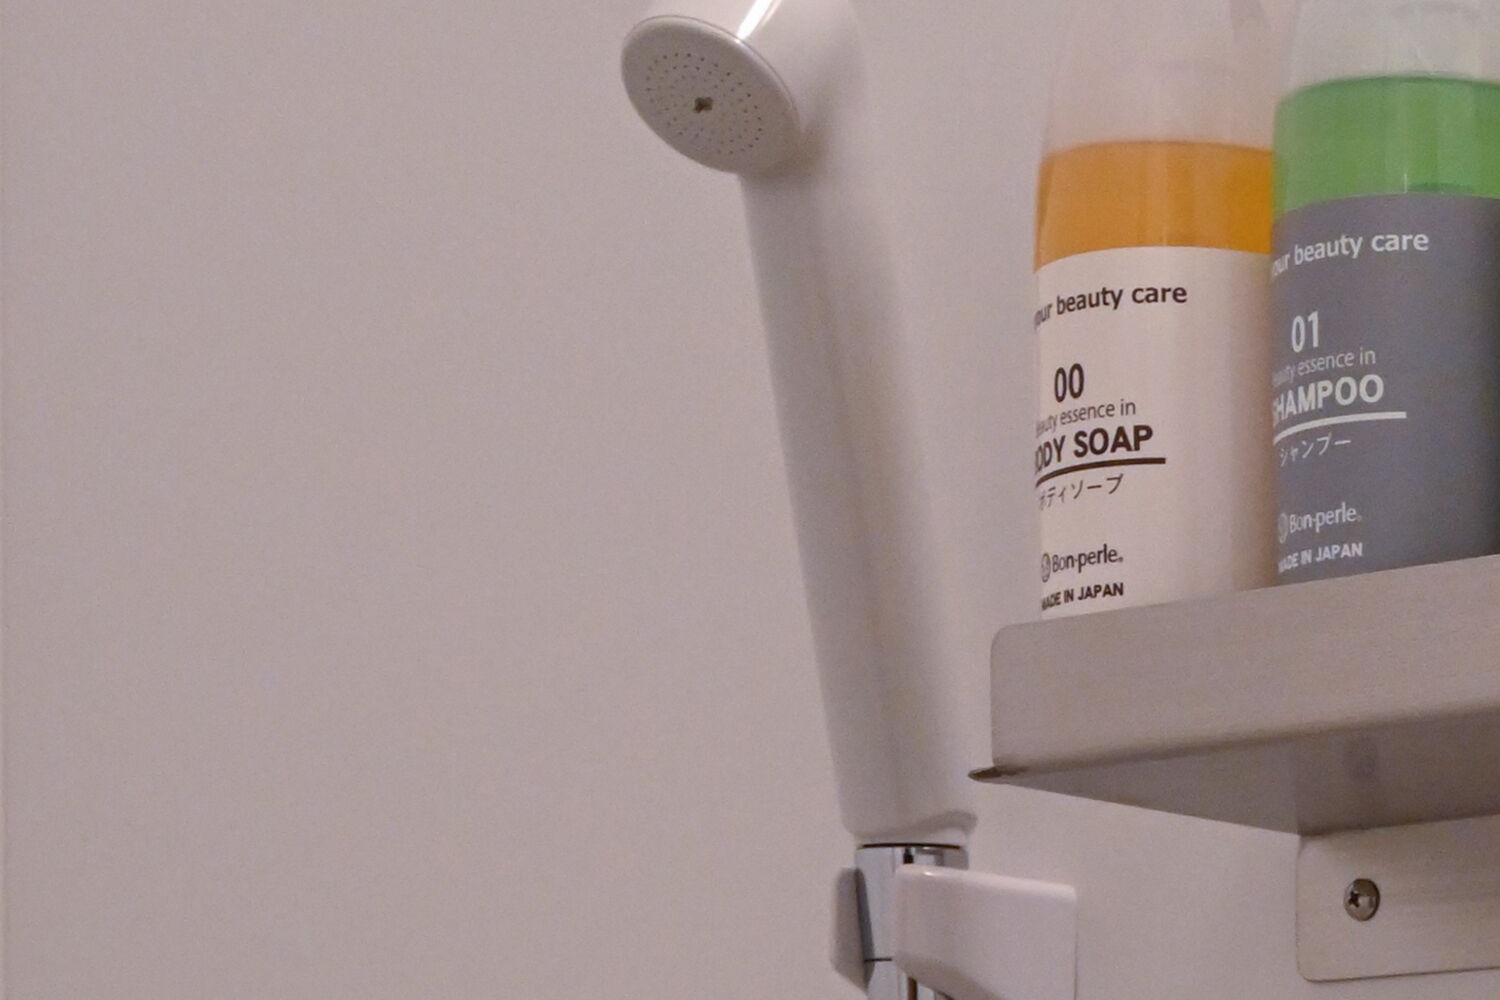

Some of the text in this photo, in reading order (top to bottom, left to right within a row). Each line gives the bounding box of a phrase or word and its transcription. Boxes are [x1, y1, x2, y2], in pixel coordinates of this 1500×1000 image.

[1272, 233, 1430, 276] our beauty care
[1034, 286, 1188, 330] our beauty care
[1291, 310, 1319, 353] 01
[1297, 351, 1355, 376] essence
[1359, 346, 1376, 365] in
[1054, 363, 1085, 403] 00
[1273, 373, 1385, 427] HAMPOO
[1060, 402, 1115, 425] essence
[1120, 399, 1136, 416] in
[1035, 424, 1153, 475] ODY SOAP
[1279, 432, 1351, 468] シャンプー
[1301, 549, 1312, 565] IN
[1315, 542, 1363, 562] JAPAN
[1063, 588, 1074, 604] IN
[1078, 583, 1124, 601] JAPAN
